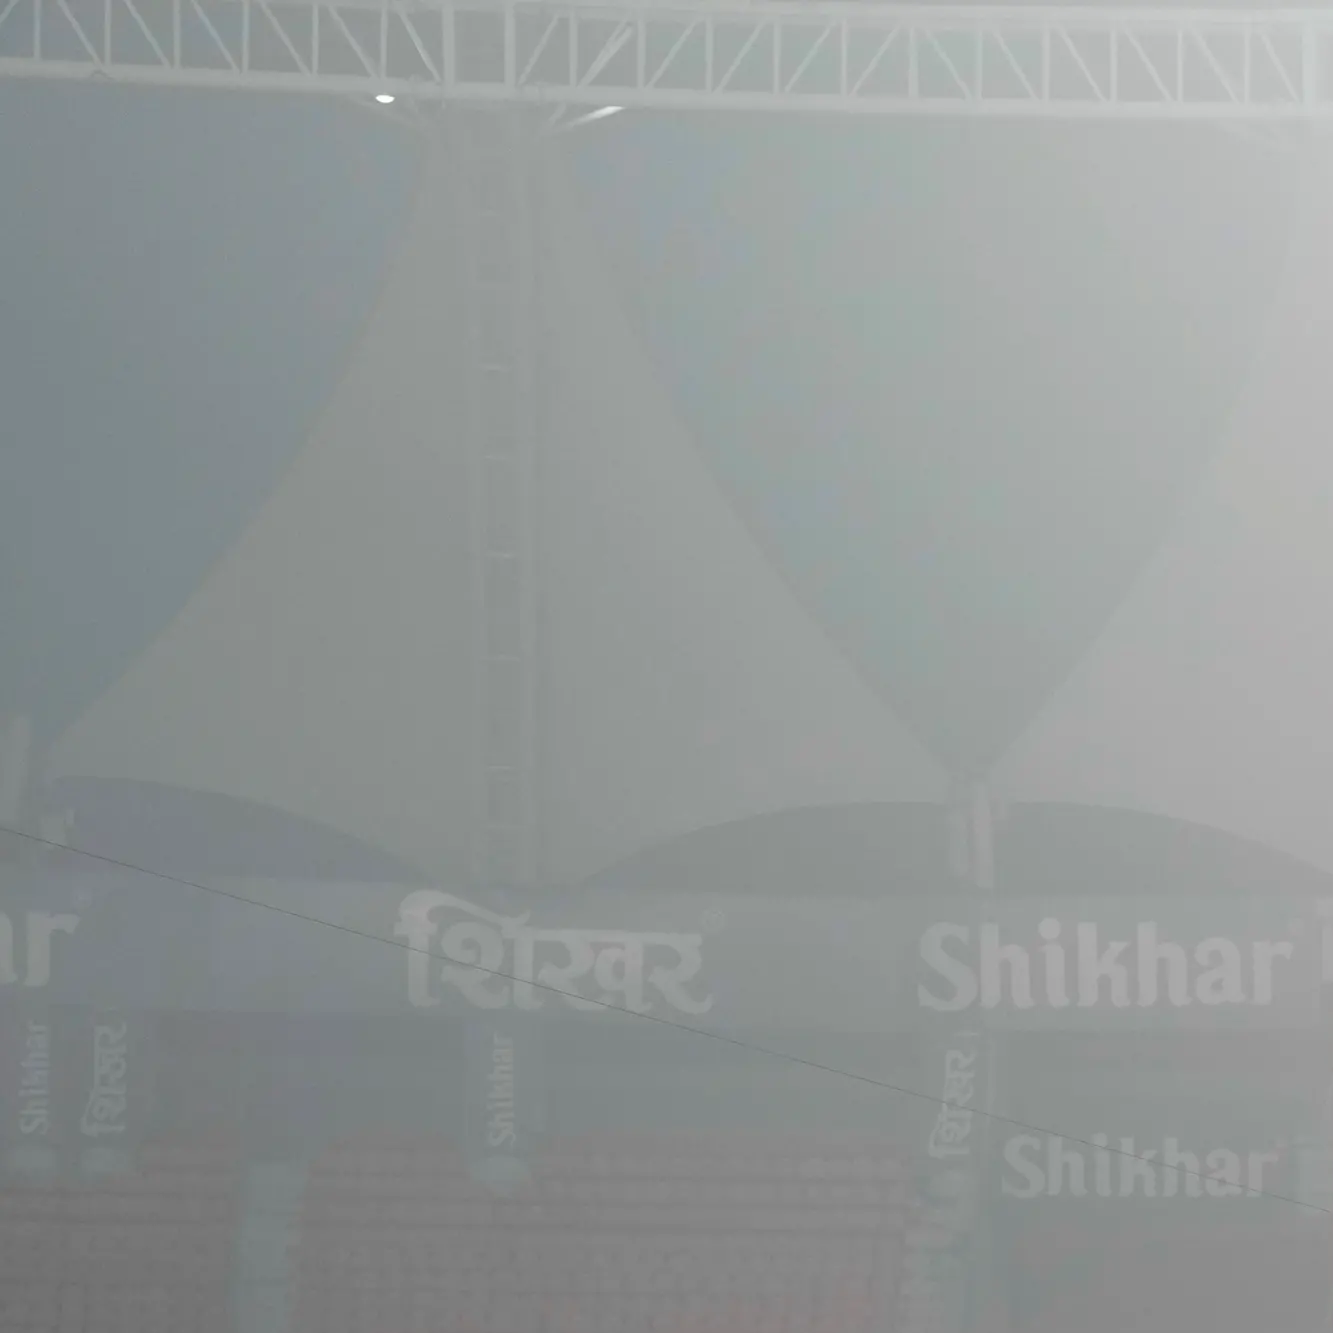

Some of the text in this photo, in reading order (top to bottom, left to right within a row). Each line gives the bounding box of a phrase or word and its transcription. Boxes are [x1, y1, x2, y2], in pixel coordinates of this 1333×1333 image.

[393, 888, 713, 1014] शिखर
[917, 915, 1294, 1012] Shikhar
[1002, 1131, 1279, 1199] Shikhar
